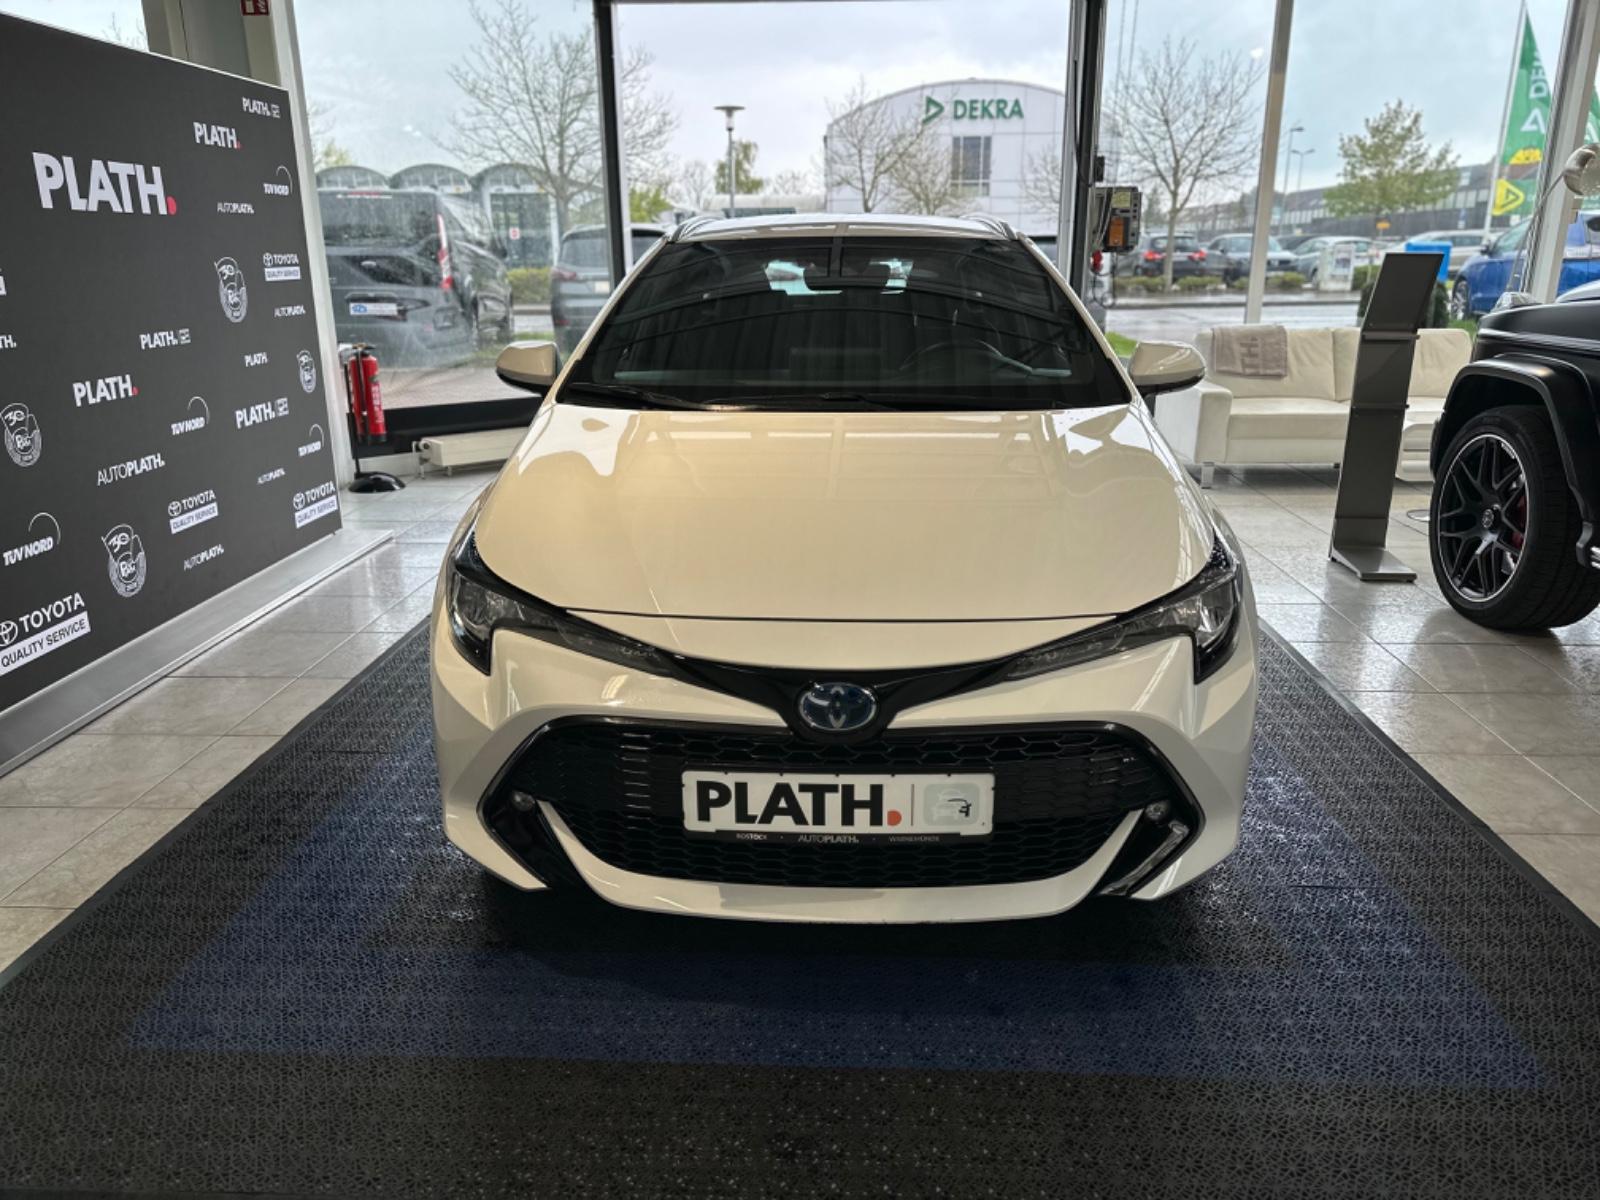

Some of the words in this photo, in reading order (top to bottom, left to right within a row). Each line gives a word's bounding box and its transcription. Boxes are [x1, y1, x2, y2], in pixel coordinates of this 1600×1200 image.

[953, 98, 1024, 120] DEKRA
[193, 121, 241, 149] PLATH.
[32, 152, 177, 215] PLATH.
[273, 253, 299, 265] TOYOTA
[72, 373, 139, 407] PLATH.
[235, 400, 276, 429] PLATH.
[97, 452, 166, 486] AUTOPLATH.
[182, 489, 216, 510] TOYOTA
[305, 480, 336, 503] TOYOTA
[24, 535, 53, 559] NORD
[19, 592, 85, 633] TOYOTA
[1, 638, 44, 668] QUALITY
[45, 619, 86, 646] SERVICE
[696, 780, 902, 827] PLATH.
